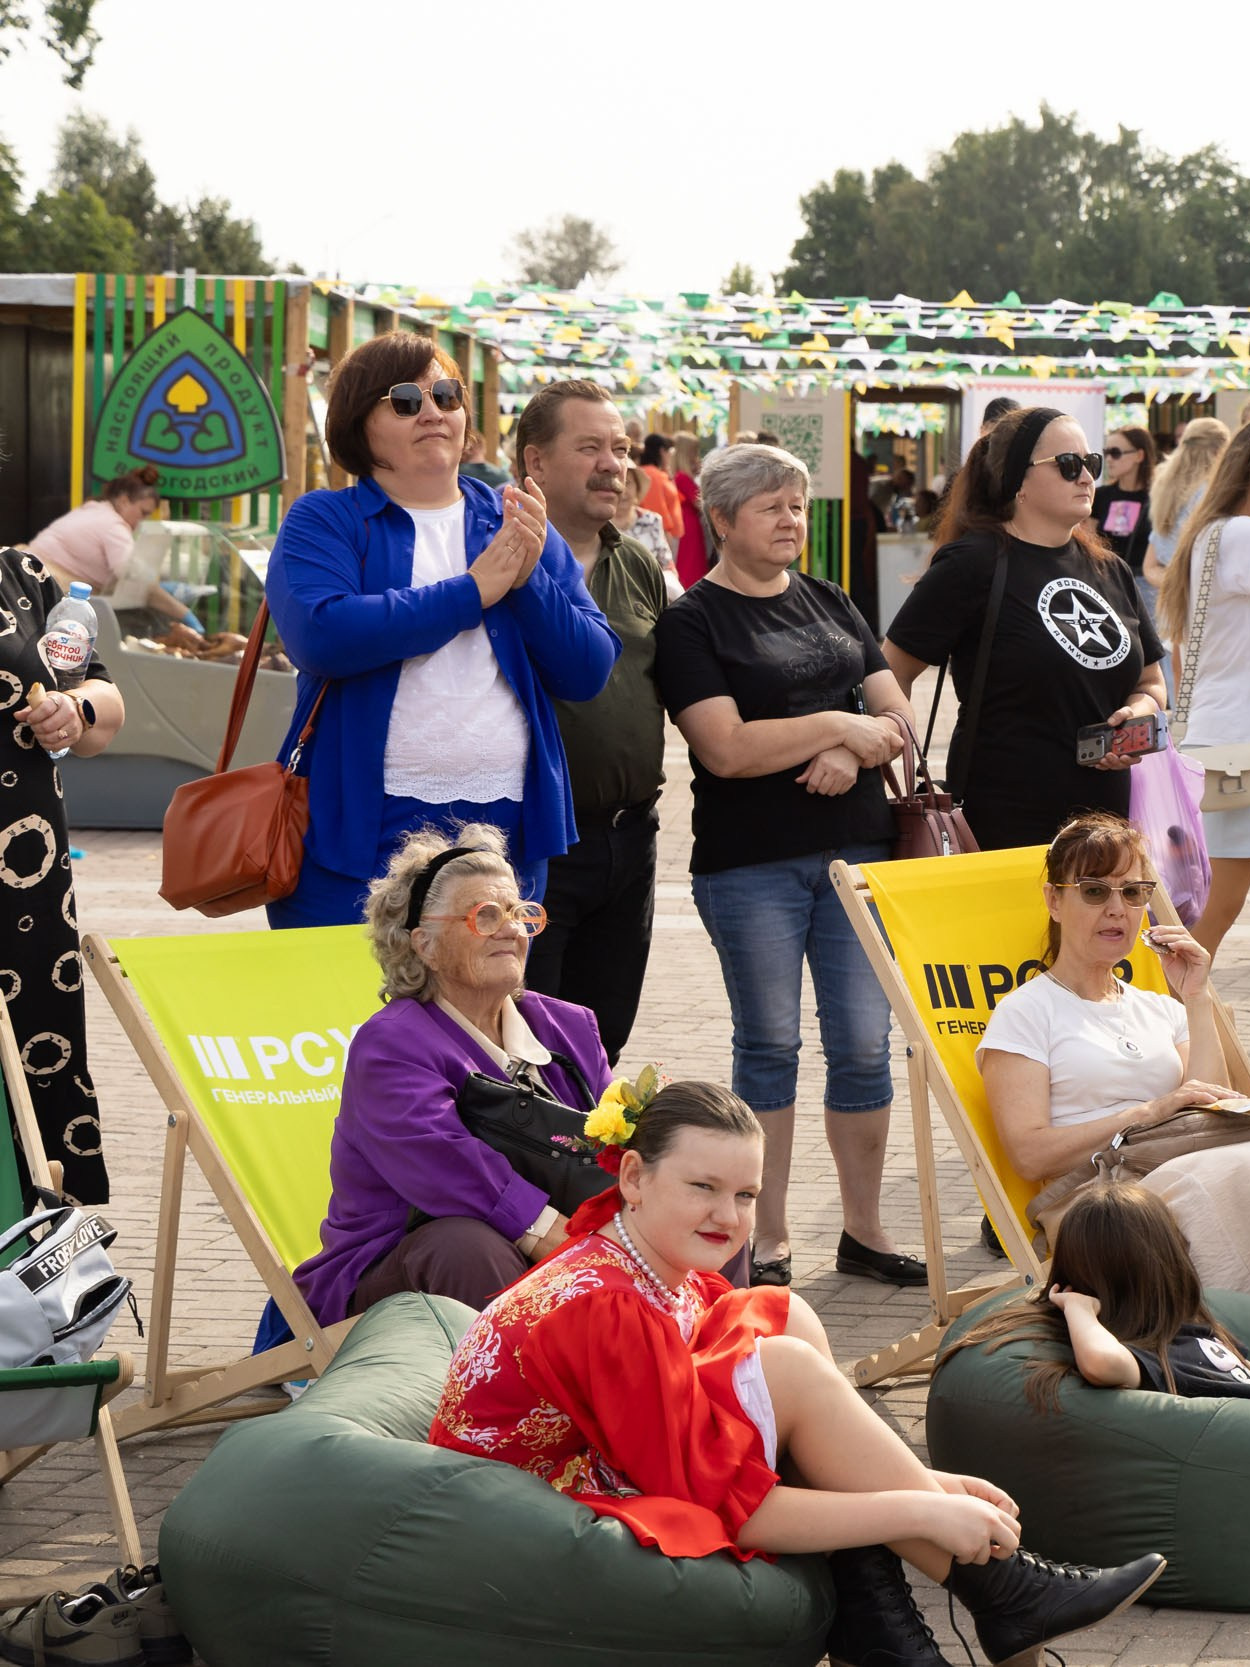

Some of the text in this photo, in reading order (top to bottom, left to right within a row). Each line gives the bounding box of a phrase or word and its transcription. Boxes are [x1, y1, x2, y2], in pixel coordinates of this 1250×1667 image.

[106, 331, 181, 453] настоящий
[204, 342, 269, 448] продукт
[114, 461, 260, 491] вогодский
[1040, 580, 1112, 612] ЖЕНА ВОЕННОГО
[1053, 630, 1129, 666] АРМИИ РОССИИ
[936, 1020, 987, 1035] ГЕНЕР
[248, 1024, 363, 1080] РСУ
[211, 1084, 342, 1104] ГЕНЕРАЛЬНЫЙ
